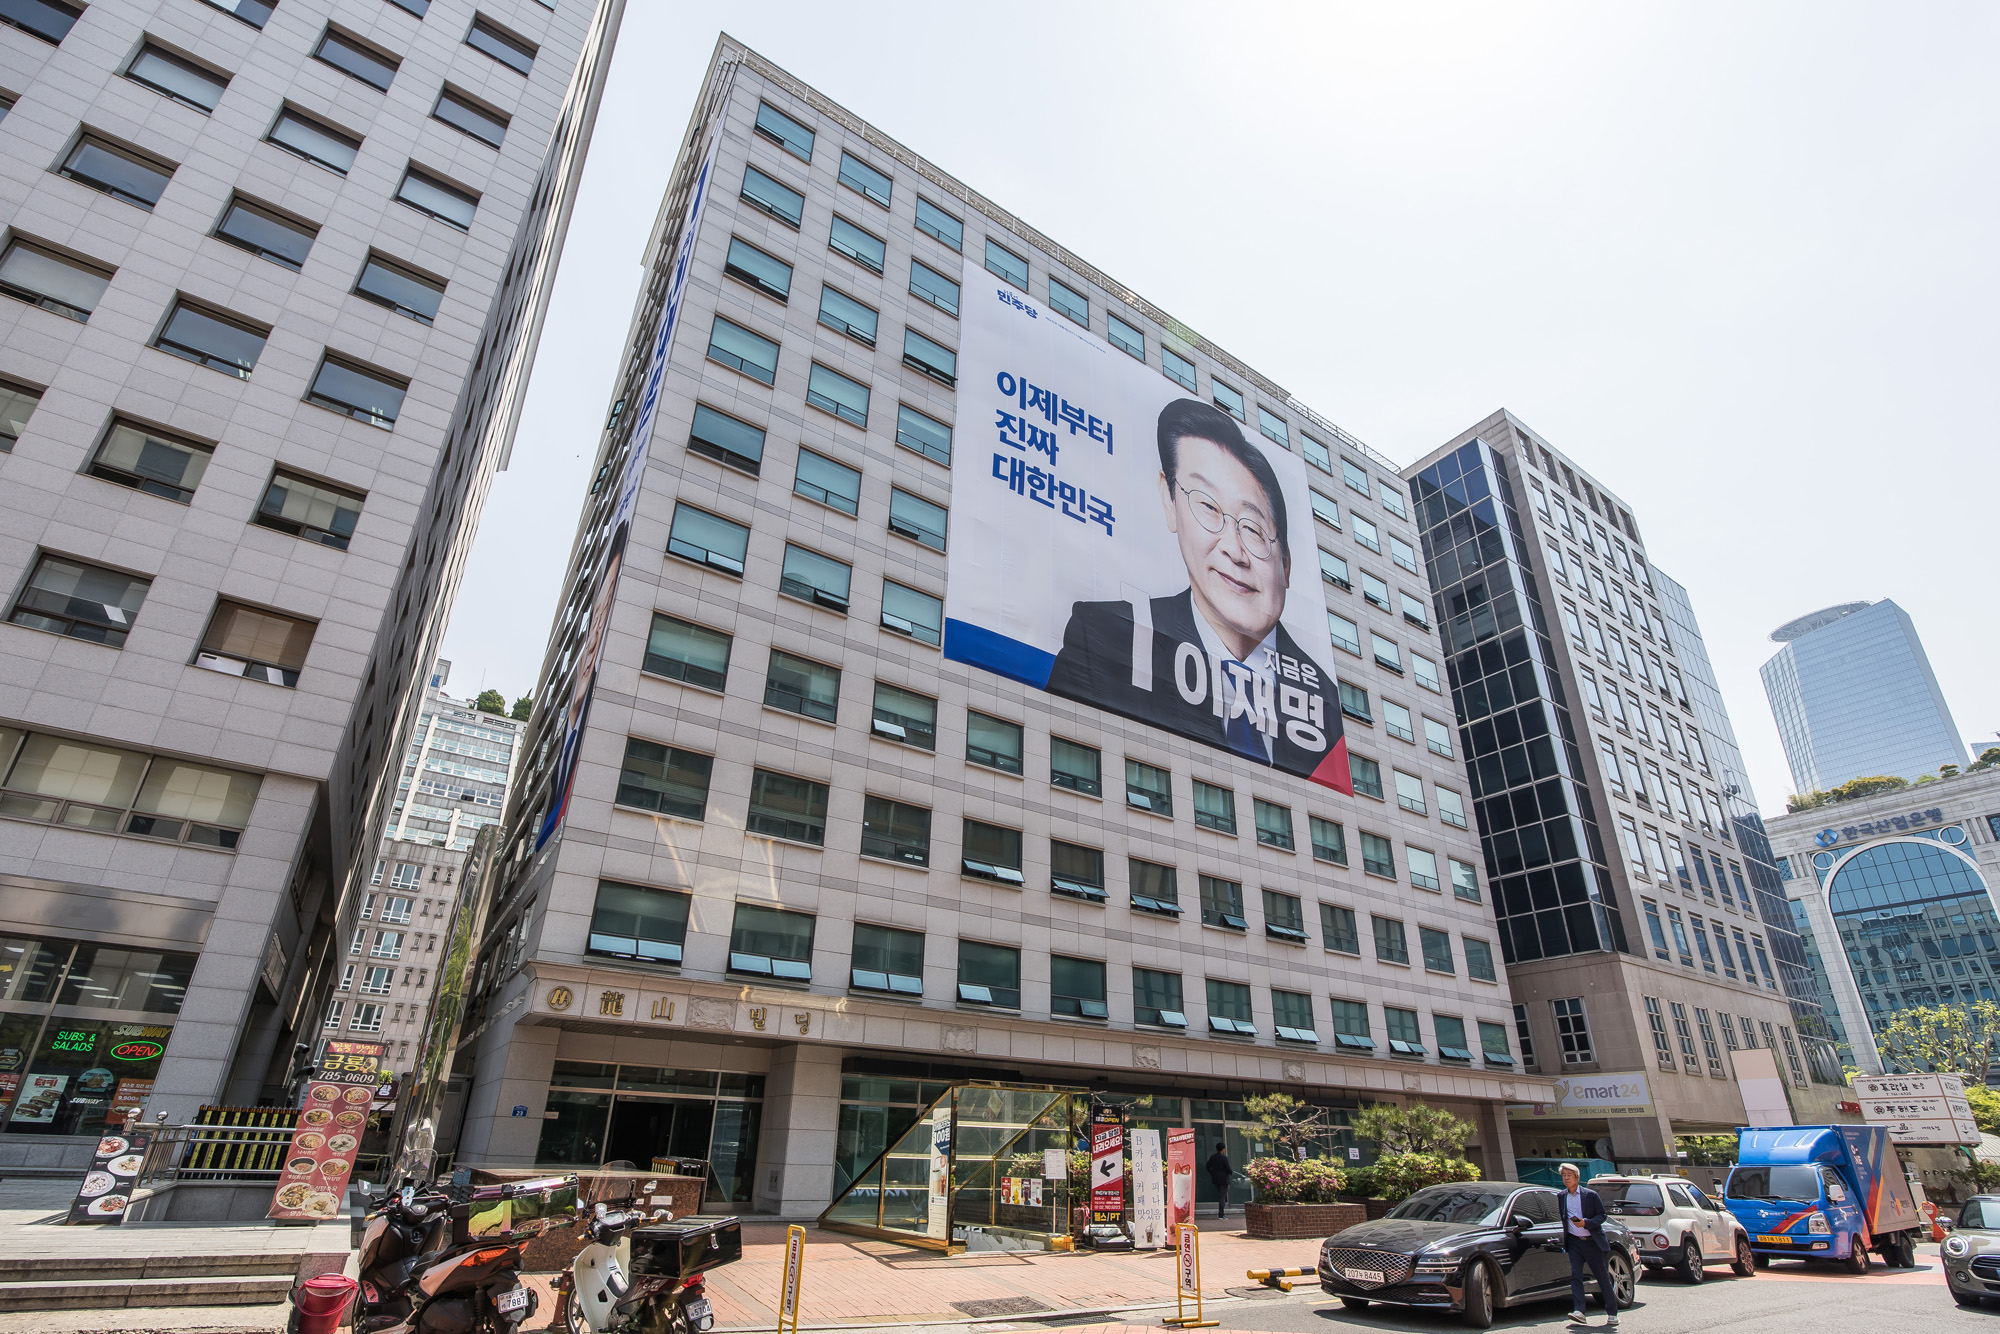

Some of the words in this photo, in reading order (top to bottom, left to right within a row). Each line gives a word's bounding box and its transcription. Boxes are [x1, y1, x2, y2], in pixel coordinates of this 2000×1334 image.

[997, 289, 1039, 320] 민주당
[996, 371, 1113, 455] 이제부터
[994, 408, 1060, 467] 진짜
[991, 453, 1116, 538] 대한민국
[1120, 580, 1155, 693] 1
[1263, 646, 1320, 688] 지금은
[1174, 641, 1328, 753] 이재명
[1841, 807, 1943, 840] 한국산업은행
[113, 1025, 173, 1038] SUBWAY
[749, 1007, 812, 1035] 빌딩
[52, 1041, 94, 1052] SALADS
[57, 1031, 86, 1042] SUBS
[89, 1033, 97, 1042] &
[117, 1045, 157, 1057] OPEN
[319, 1071, 375, 1084] 785-0609
[1573, 1083, 1641, 1099] emart24
[70, 1097, 104, 1105] SUBWAY
[1364, 1272, 1382, 1281] 8445
